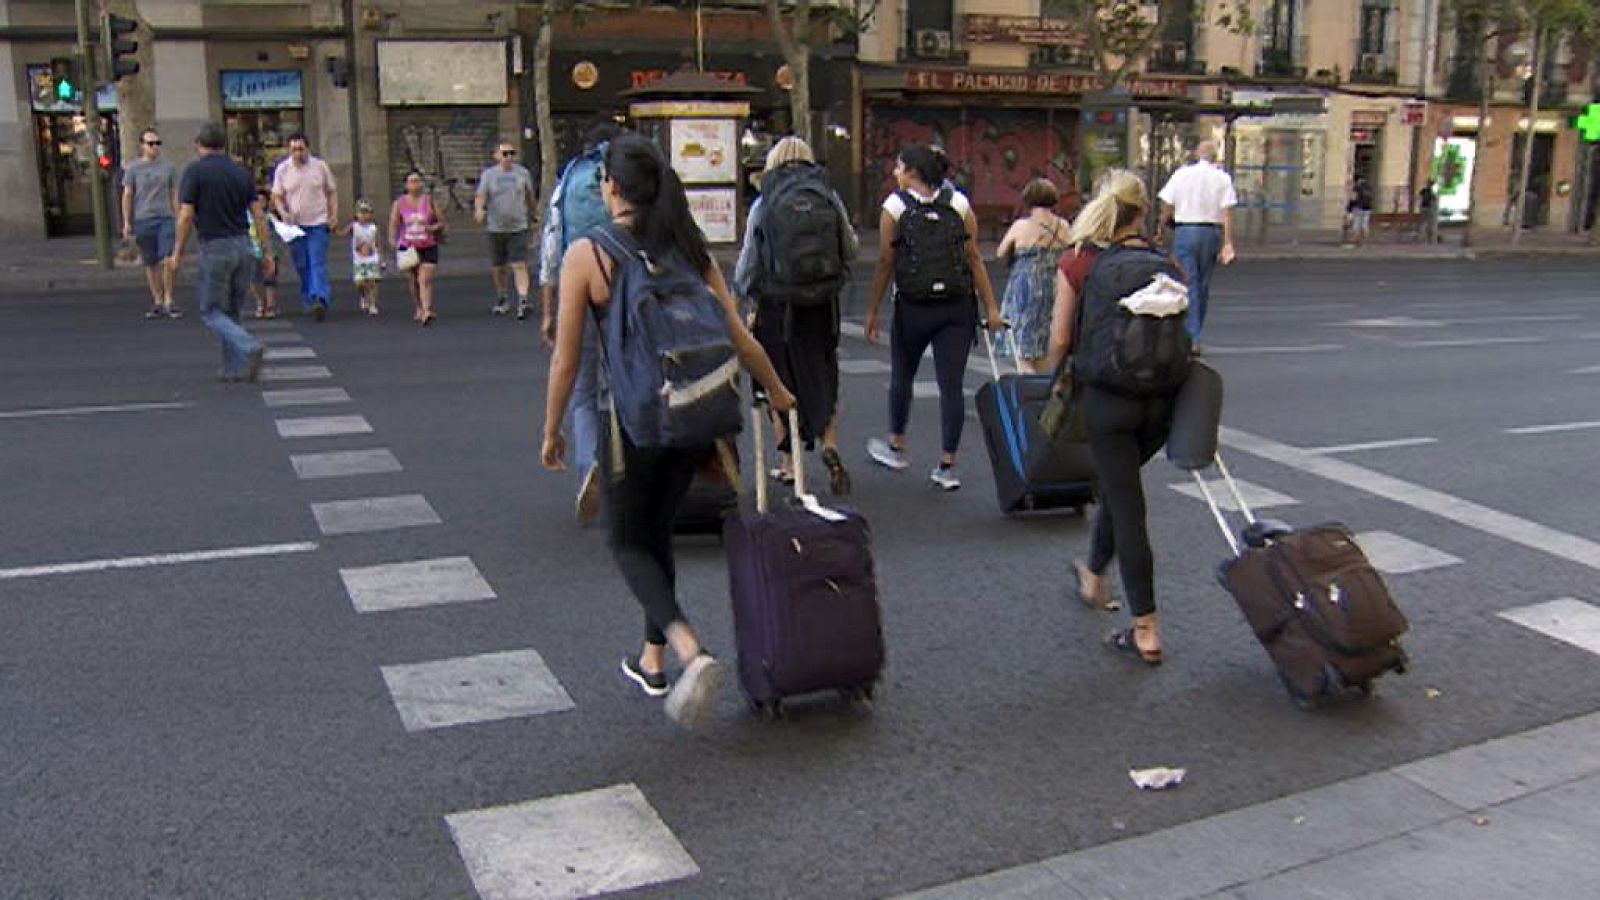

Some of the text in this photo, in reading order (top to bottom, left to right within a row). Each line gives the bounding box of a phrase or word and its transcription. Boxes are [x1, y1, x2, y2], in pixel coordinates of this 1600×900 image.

[919, 71, 941, 89] EL
[952, 71, 1028, 92] PALACIO
[1037, 74, 1063, 92] DE
